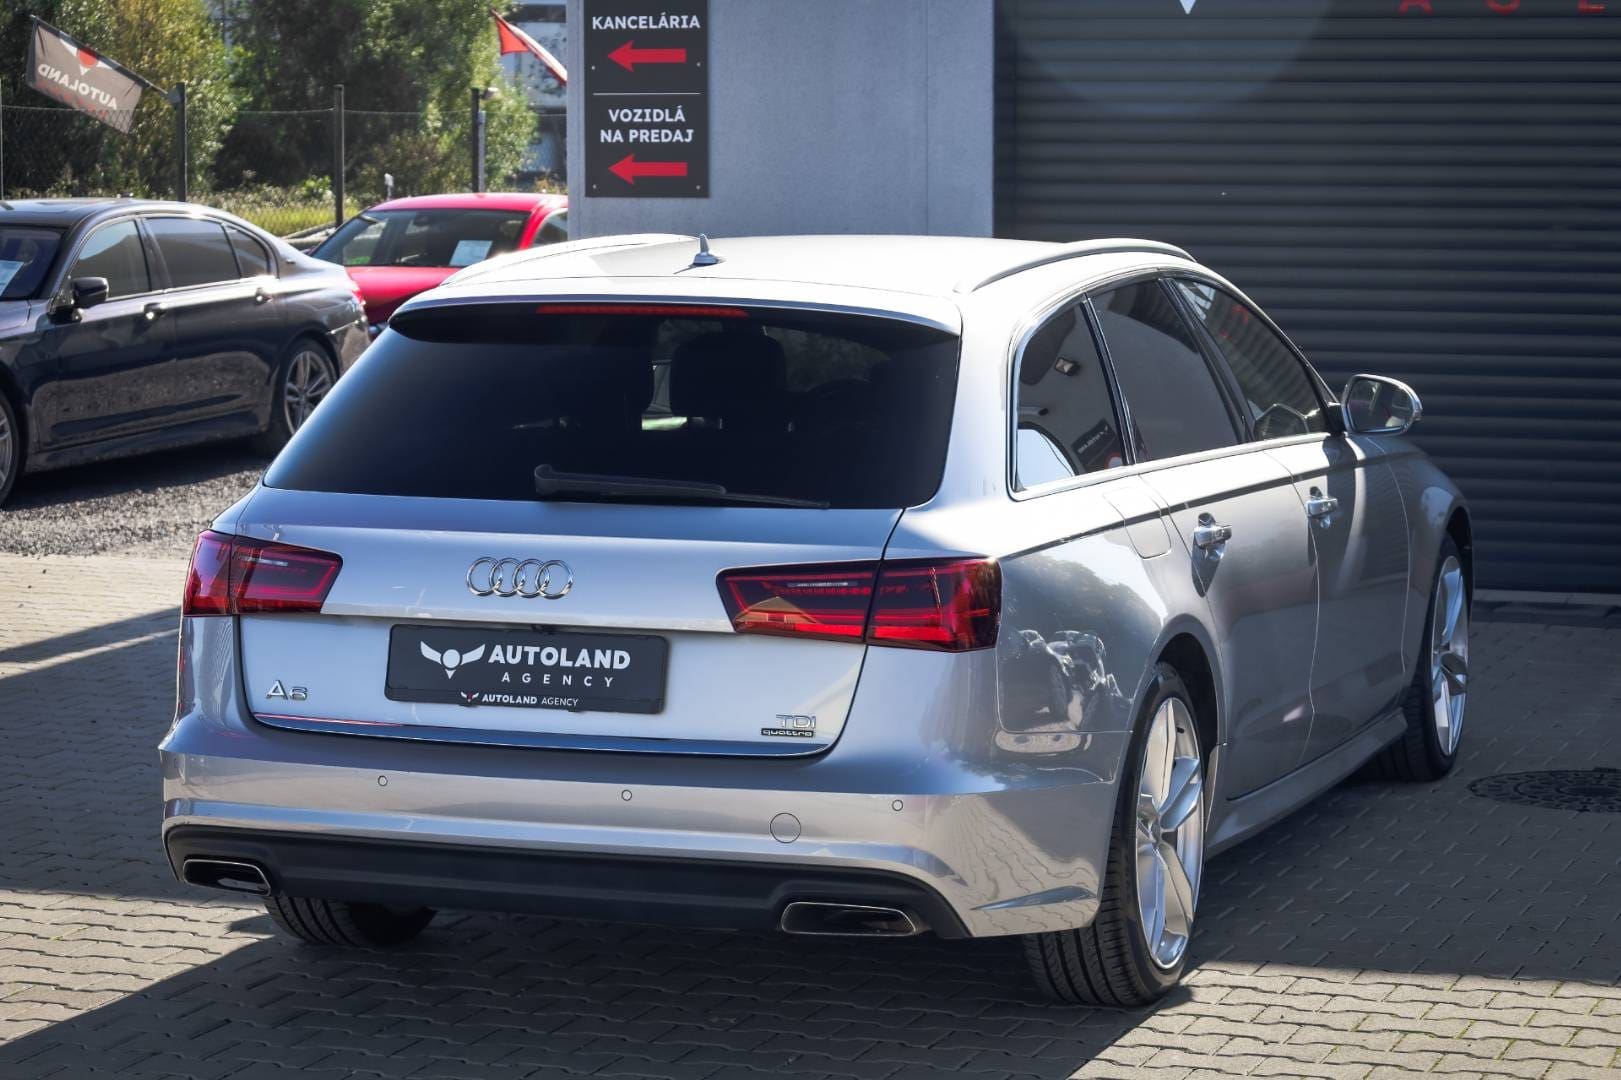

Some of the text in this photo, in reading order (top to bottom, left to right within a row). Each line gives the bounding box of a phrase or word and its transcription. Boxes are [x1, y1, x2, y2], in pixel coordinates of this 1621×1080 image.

[592, 12, 700, 30] KANCELÁRIA
[608, 105, 686, 122] VOZIDLÁ
[600, 129, 694, 143] NA PREDAJ
[488, 644, 631, 670] AUTOLAND
[501, 671, 614, 688] AGENCY
[266, 680, 308, 701] A6
[482, 693, 579, 707] AUTOLAND AGENCY
[761, 729, 814, 737] quattro
